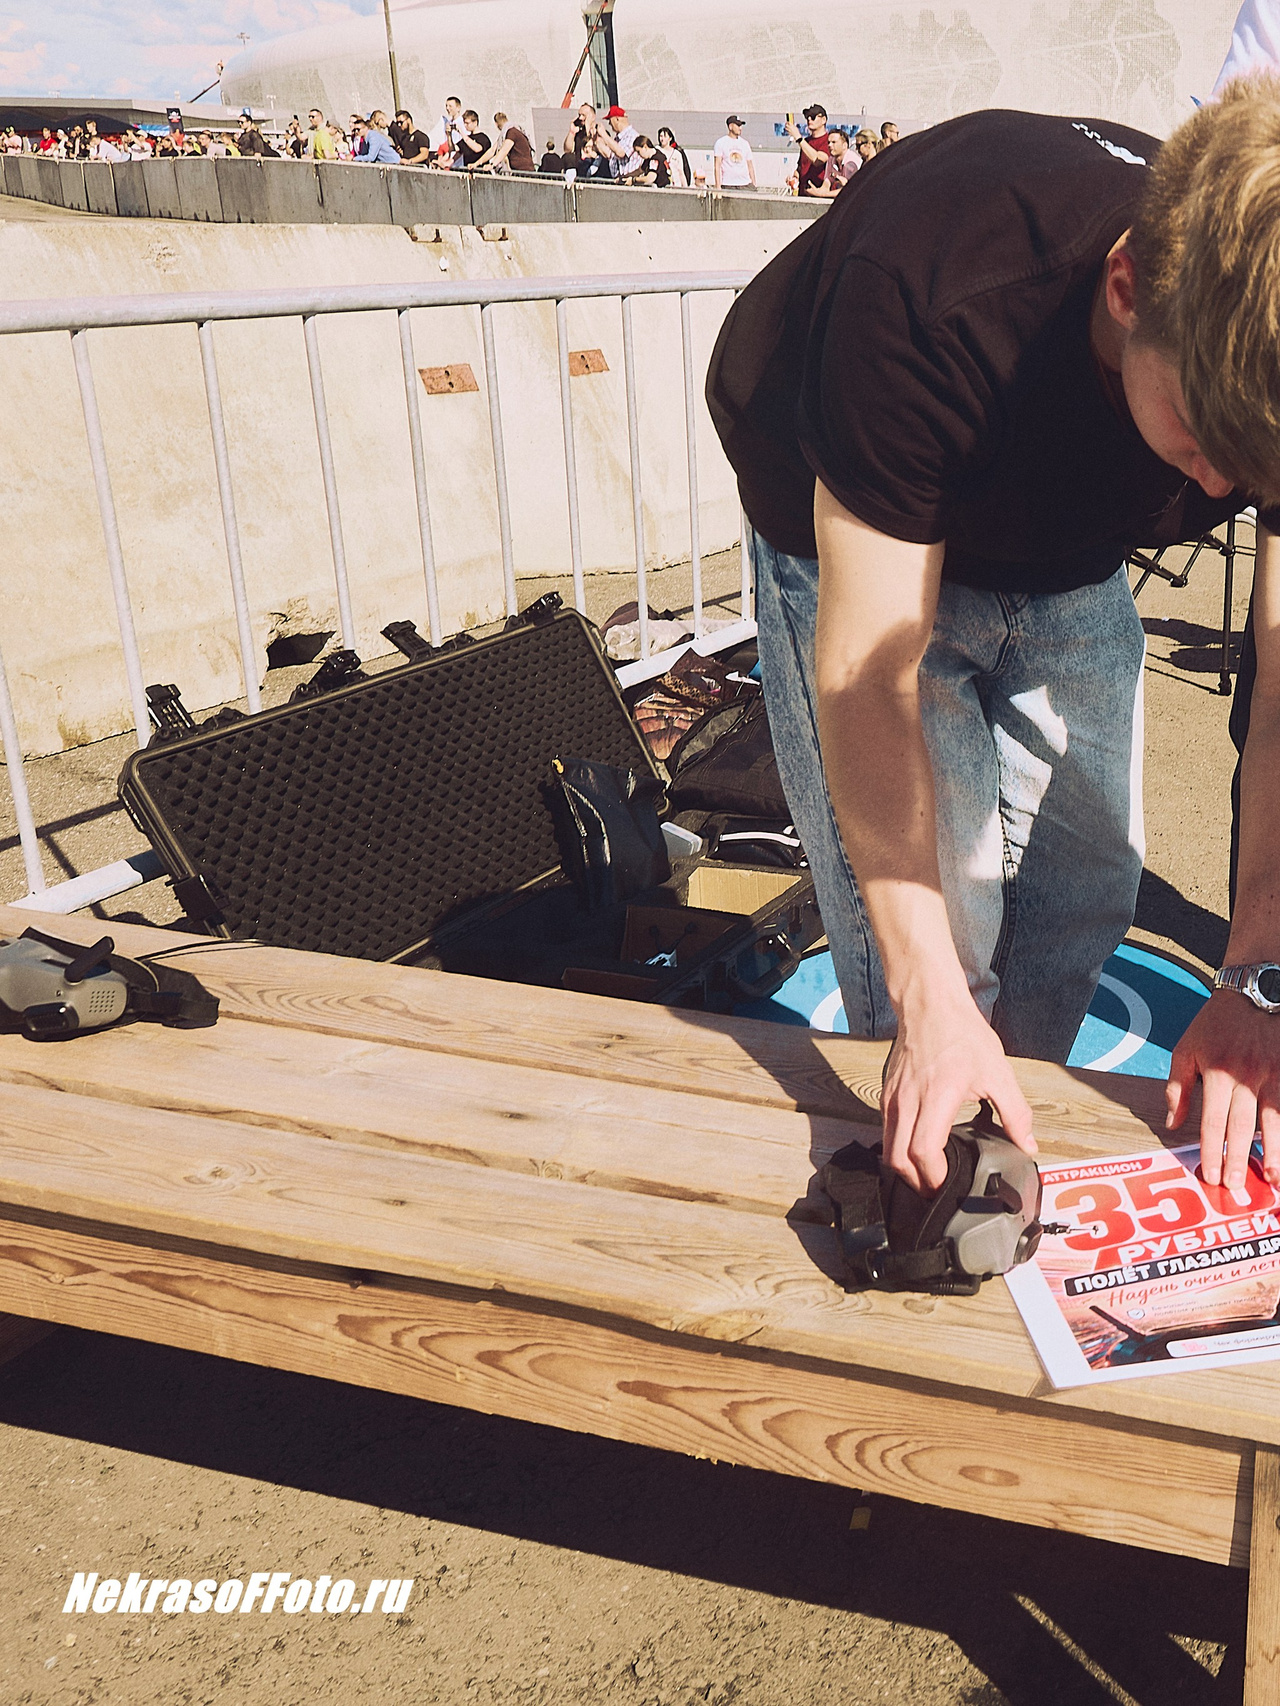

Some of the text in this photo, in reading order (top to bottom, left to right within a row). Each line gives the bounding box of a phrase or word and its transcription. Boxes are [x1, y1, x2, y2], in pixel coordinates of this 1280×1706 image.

[1042, 1160, 1143, 1184] АТТРАКЦИОН
[1073, 1264, 1151, 1293] ПОЛЁТ
[1157, 1243, 1256, 1276] ГЛАЗАМИ
[1108, 1280, 1179, 1308] Надень
[1184, 1272, 1225, 1289] очки
[1230, 1268, 1241, 1279] и
